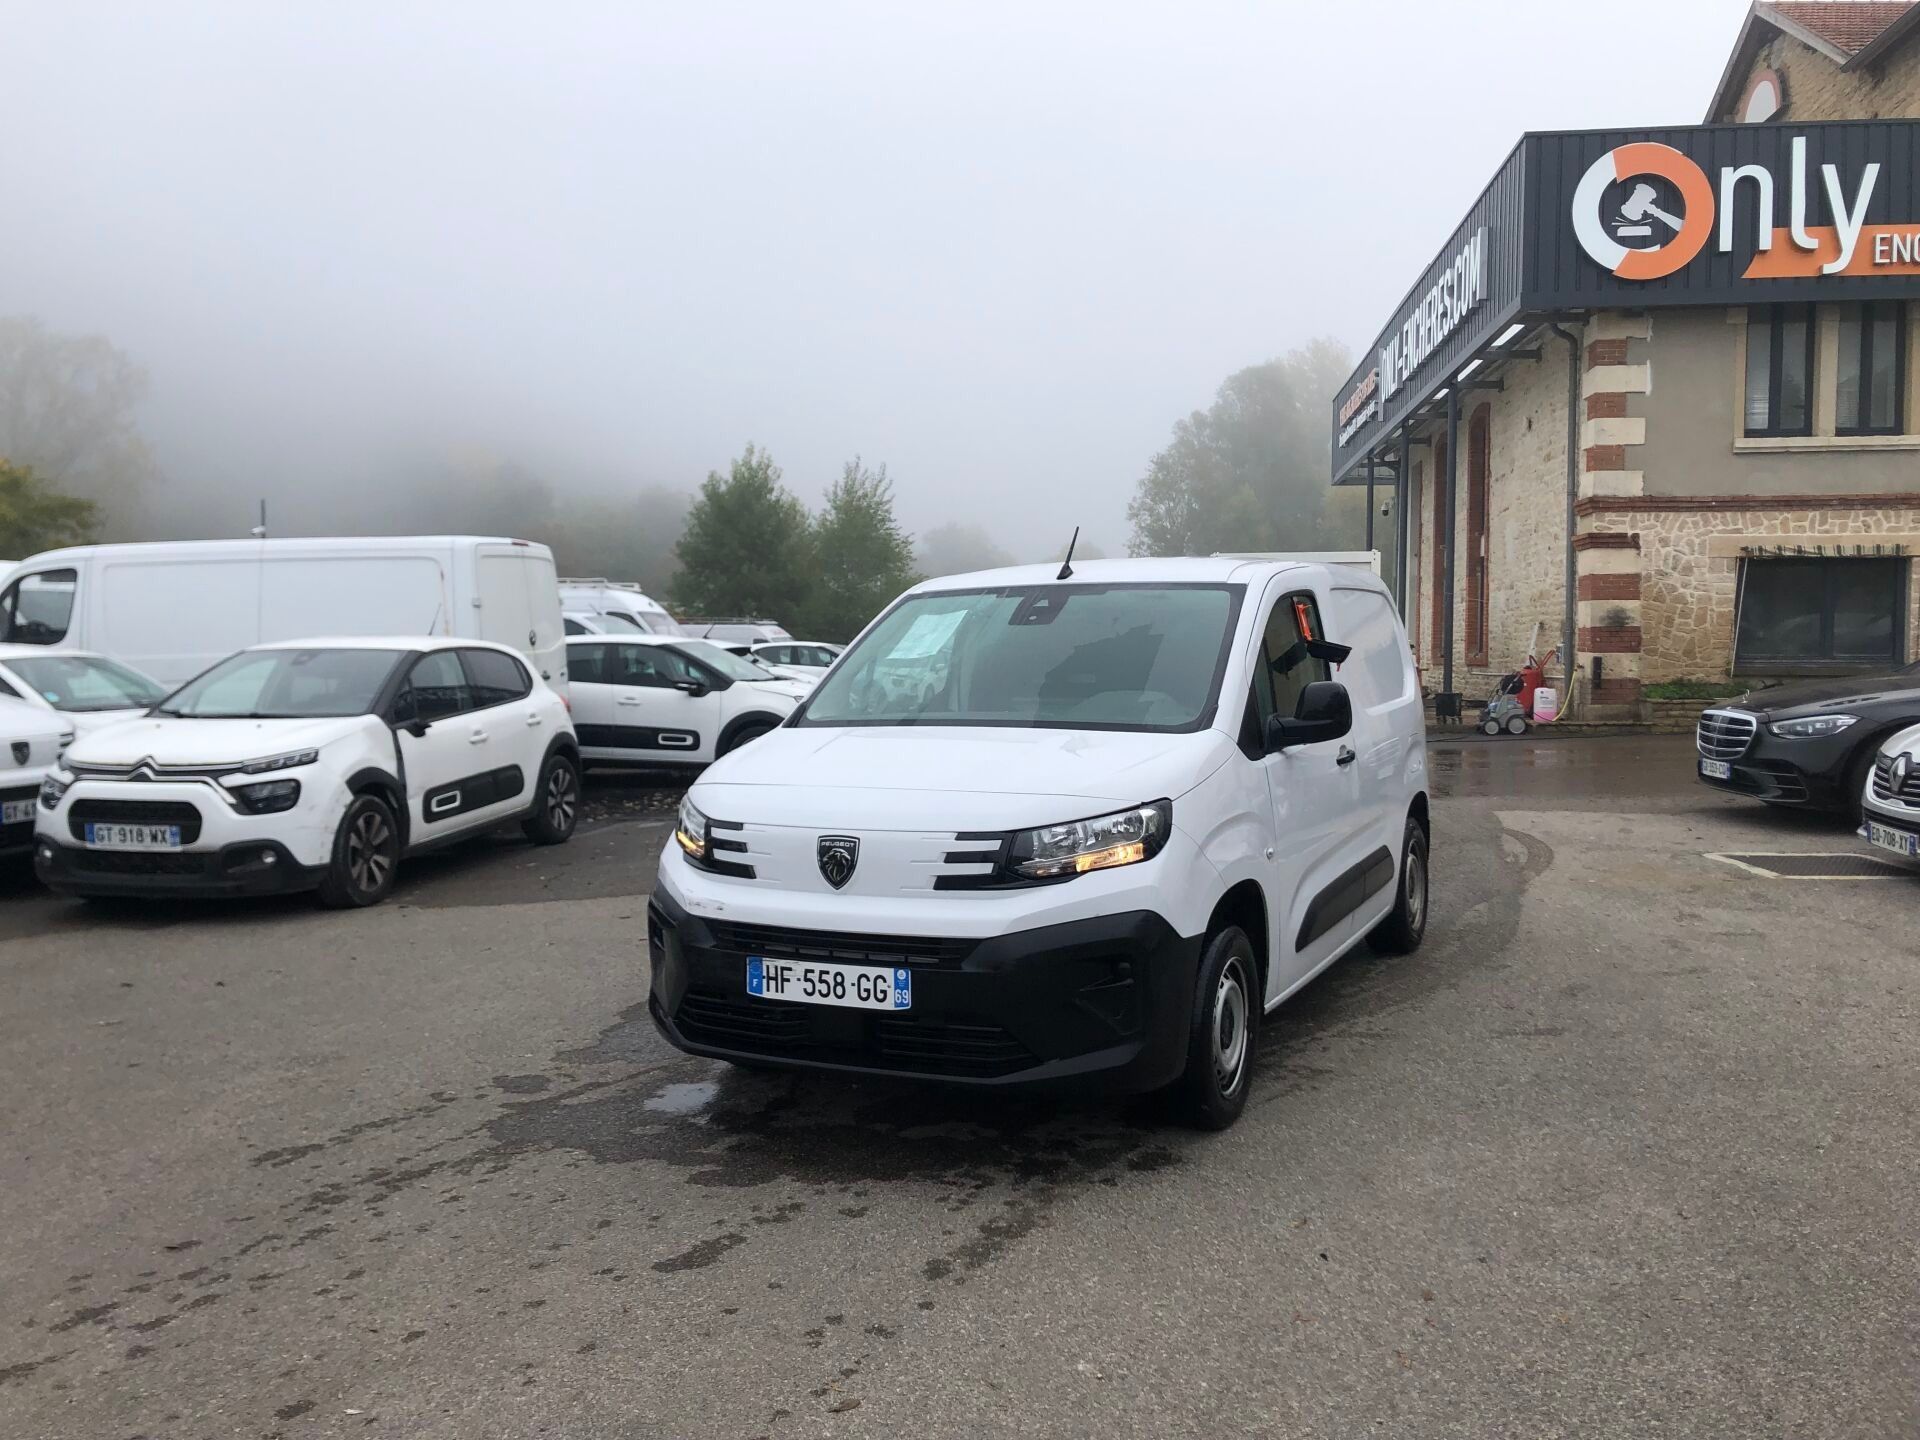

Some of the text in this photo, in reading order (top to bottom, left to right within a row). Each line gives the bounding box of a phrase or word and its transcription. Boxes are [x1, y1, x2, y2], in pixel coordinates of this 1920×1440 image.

[1572, 136, 1881, 281] Only
[1381, 228, 1485, 404] ONLY-ENCHERES.COM
[766, 964, 888, 1003] HF-558-GG
[895, 989, 909, 1004] 69
